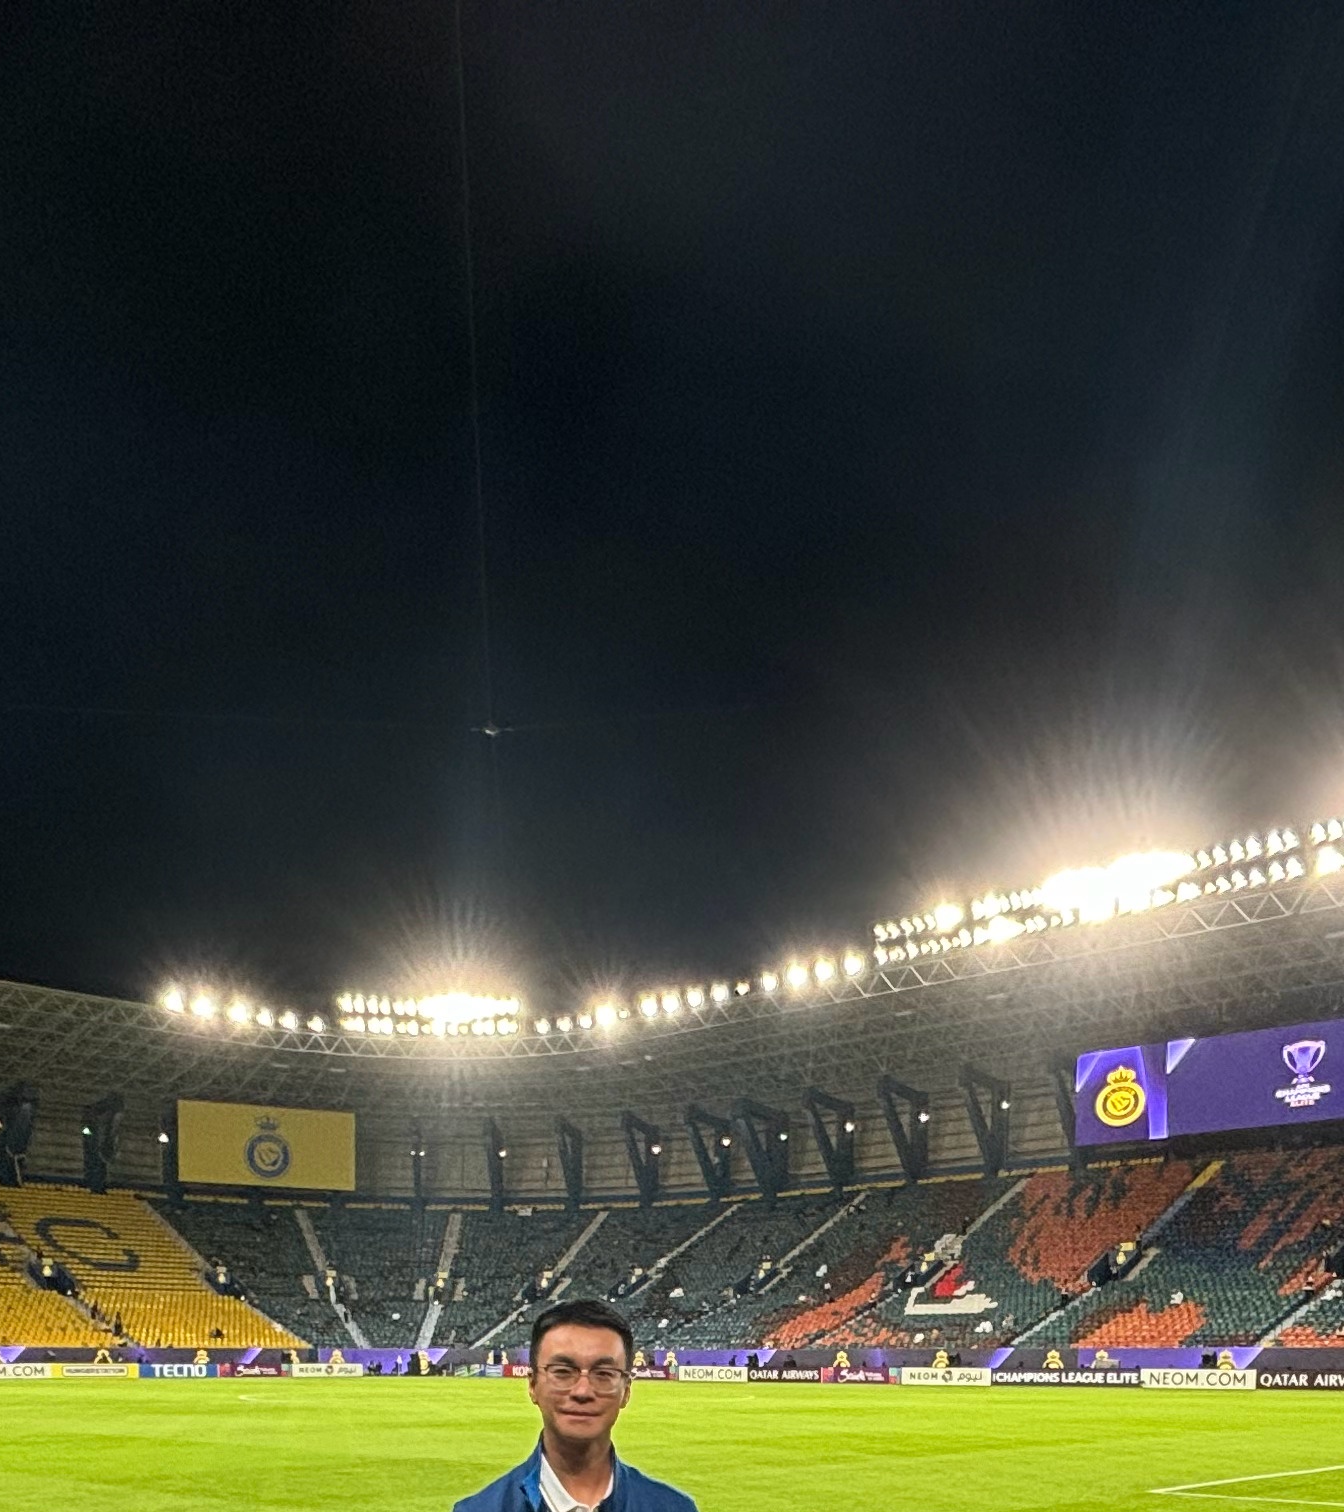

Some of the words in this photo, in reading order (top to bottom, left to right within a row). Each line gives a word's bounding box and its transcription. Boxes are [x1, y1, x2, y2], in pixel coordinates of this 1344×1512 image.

[151, 1363, 207, 1377] TECNO
[684, 1368, 742, 1380] NEOM.COM
[749, 1368, 778, 1380] QATAR
[781, 1369, 819, 1380] AIRWAYS
[909, 1372, 939, 1380] NEOM
[995, 1372, 1060, 1383] CHAMPIONS
[1062, 1372, 1105, 1384] LEAGUE
[1106, 1373, 1139, 1384] ELITE
[1149, 1372, 1246, 1387] NEOM.COM
[1259, 1373, 1309, 1388] QATAR
